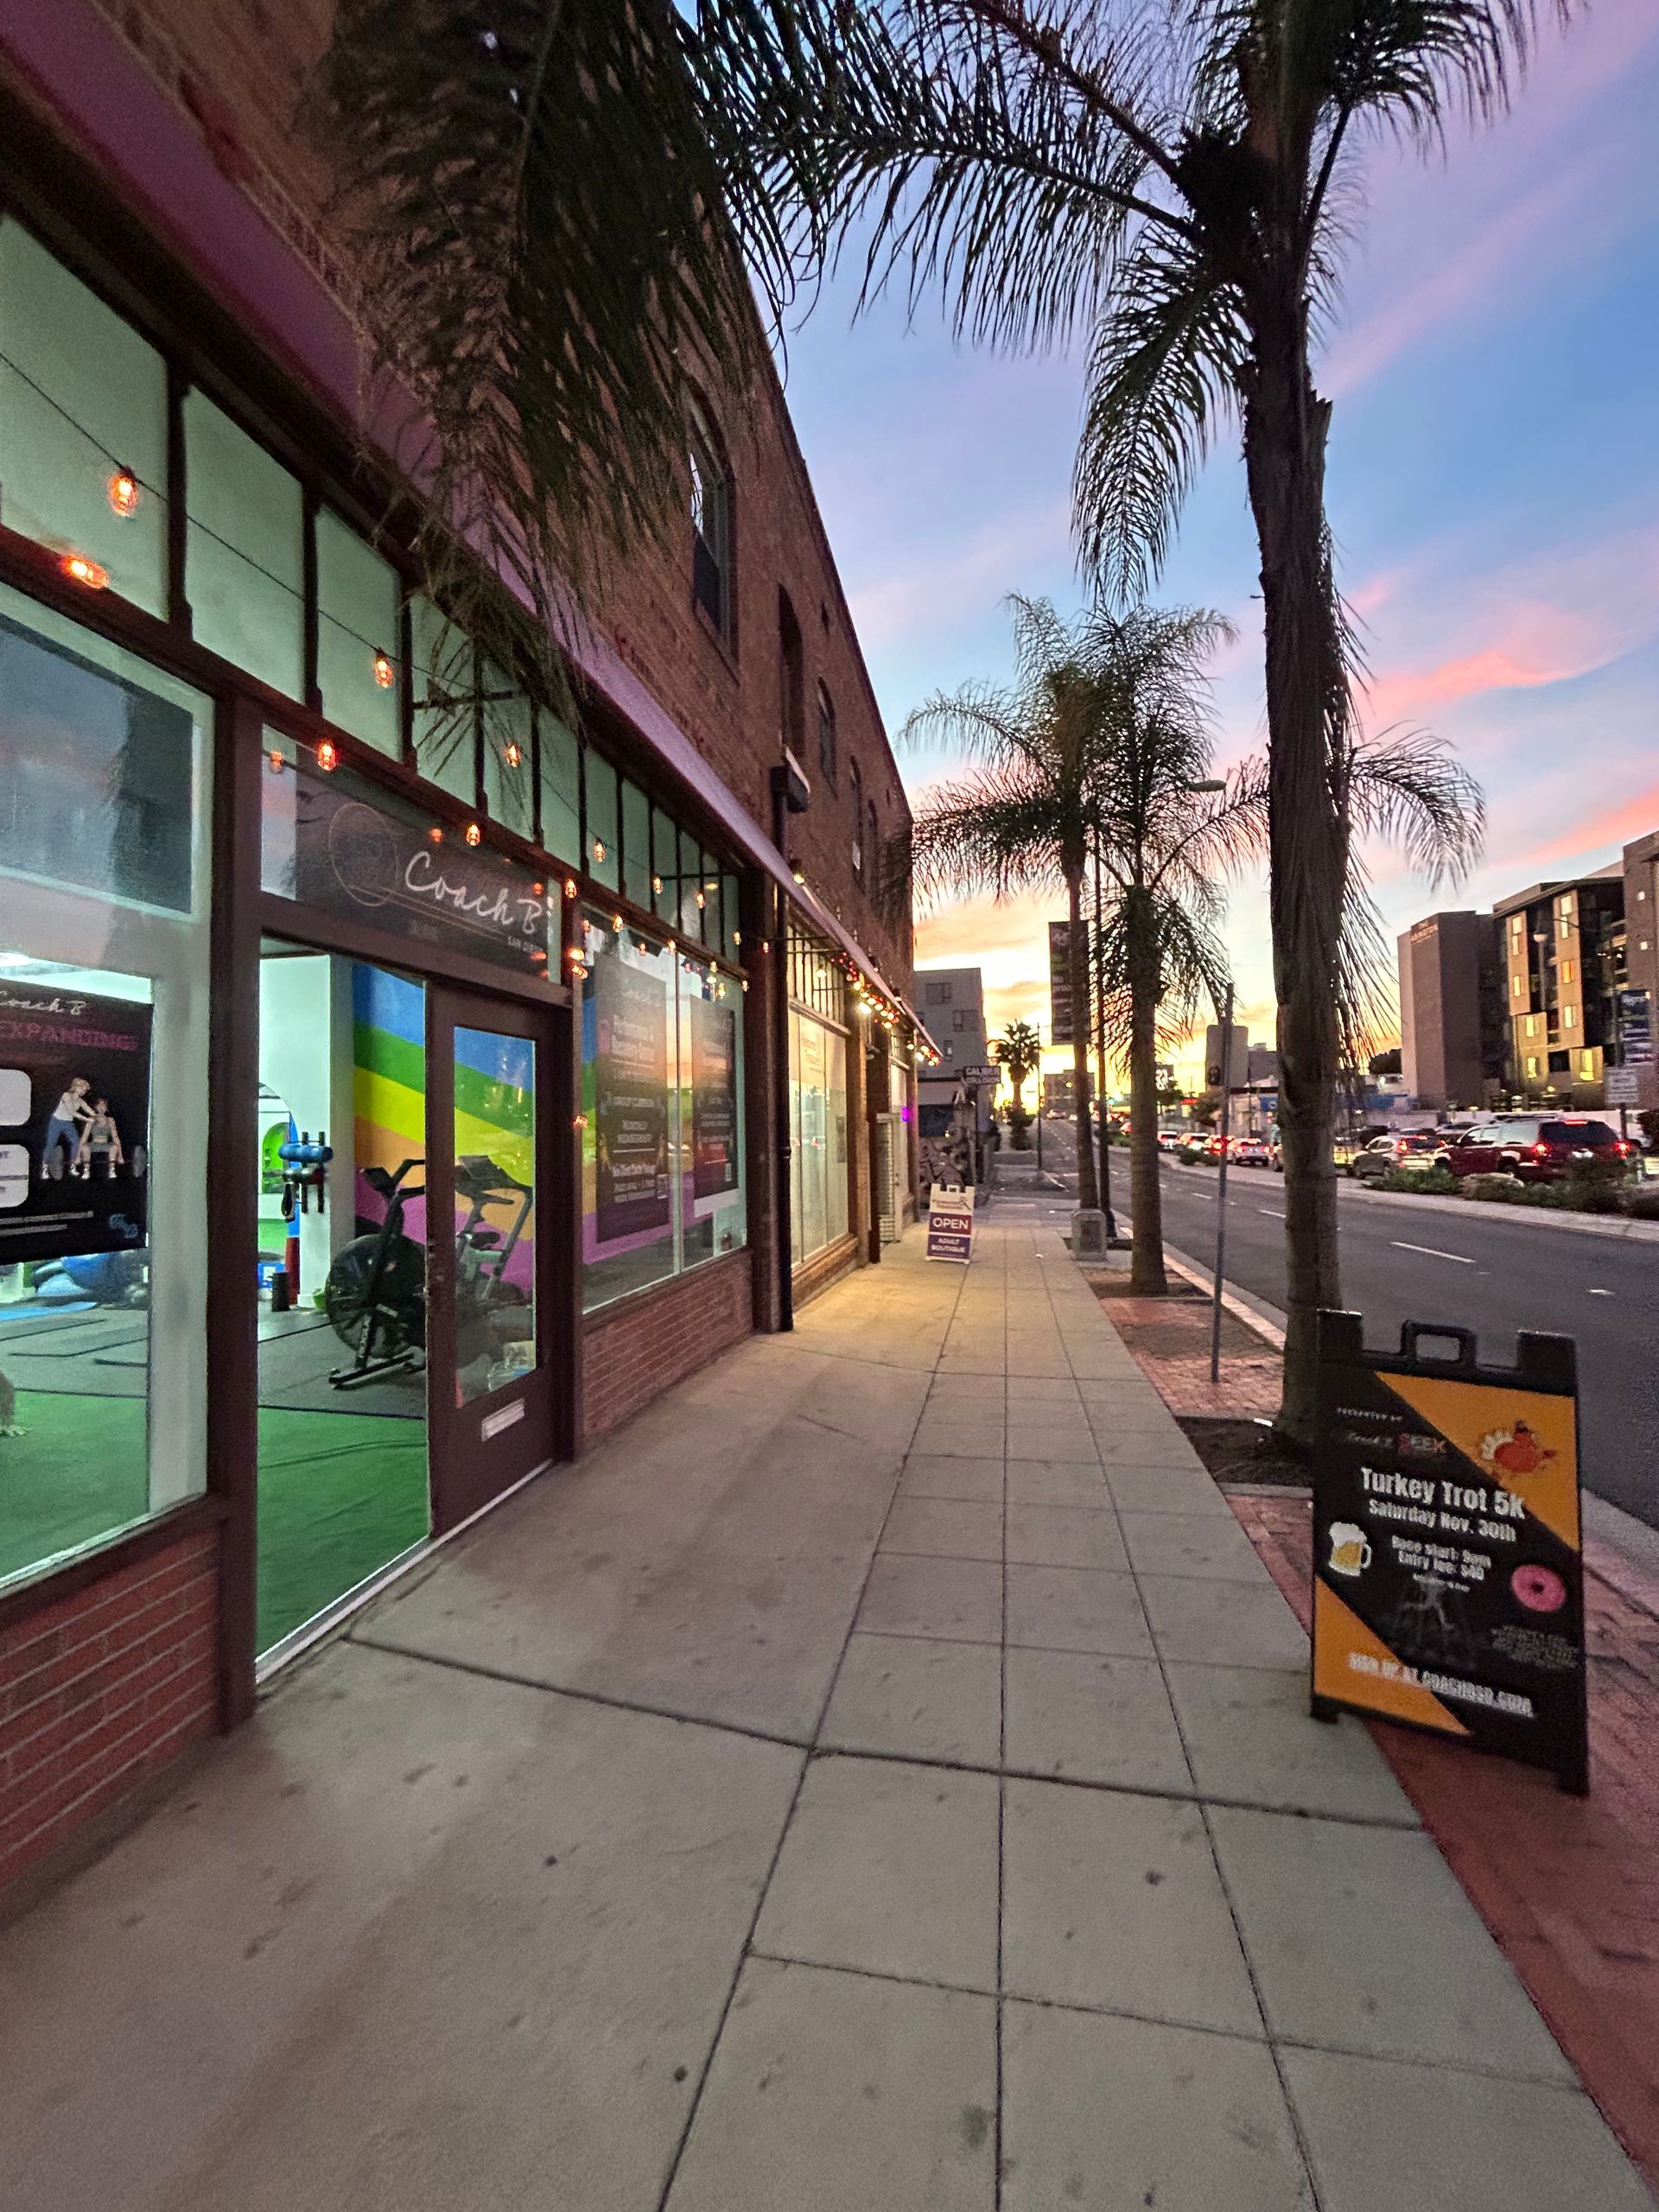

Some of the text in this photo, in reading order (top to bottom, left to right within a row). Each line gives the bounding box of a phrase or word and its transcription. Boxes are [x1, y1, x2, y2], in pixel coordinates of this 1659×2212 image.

[404, 850, 543, 934] Coach B
[932, 1217, 969, 1230] OPEN
[1361, 1466, 1435, 1505] Turkey
[1441, 1479, 1487, 1512] Trot
[1368, 1497, 1517, 1542] Saturday Nov. 30th
